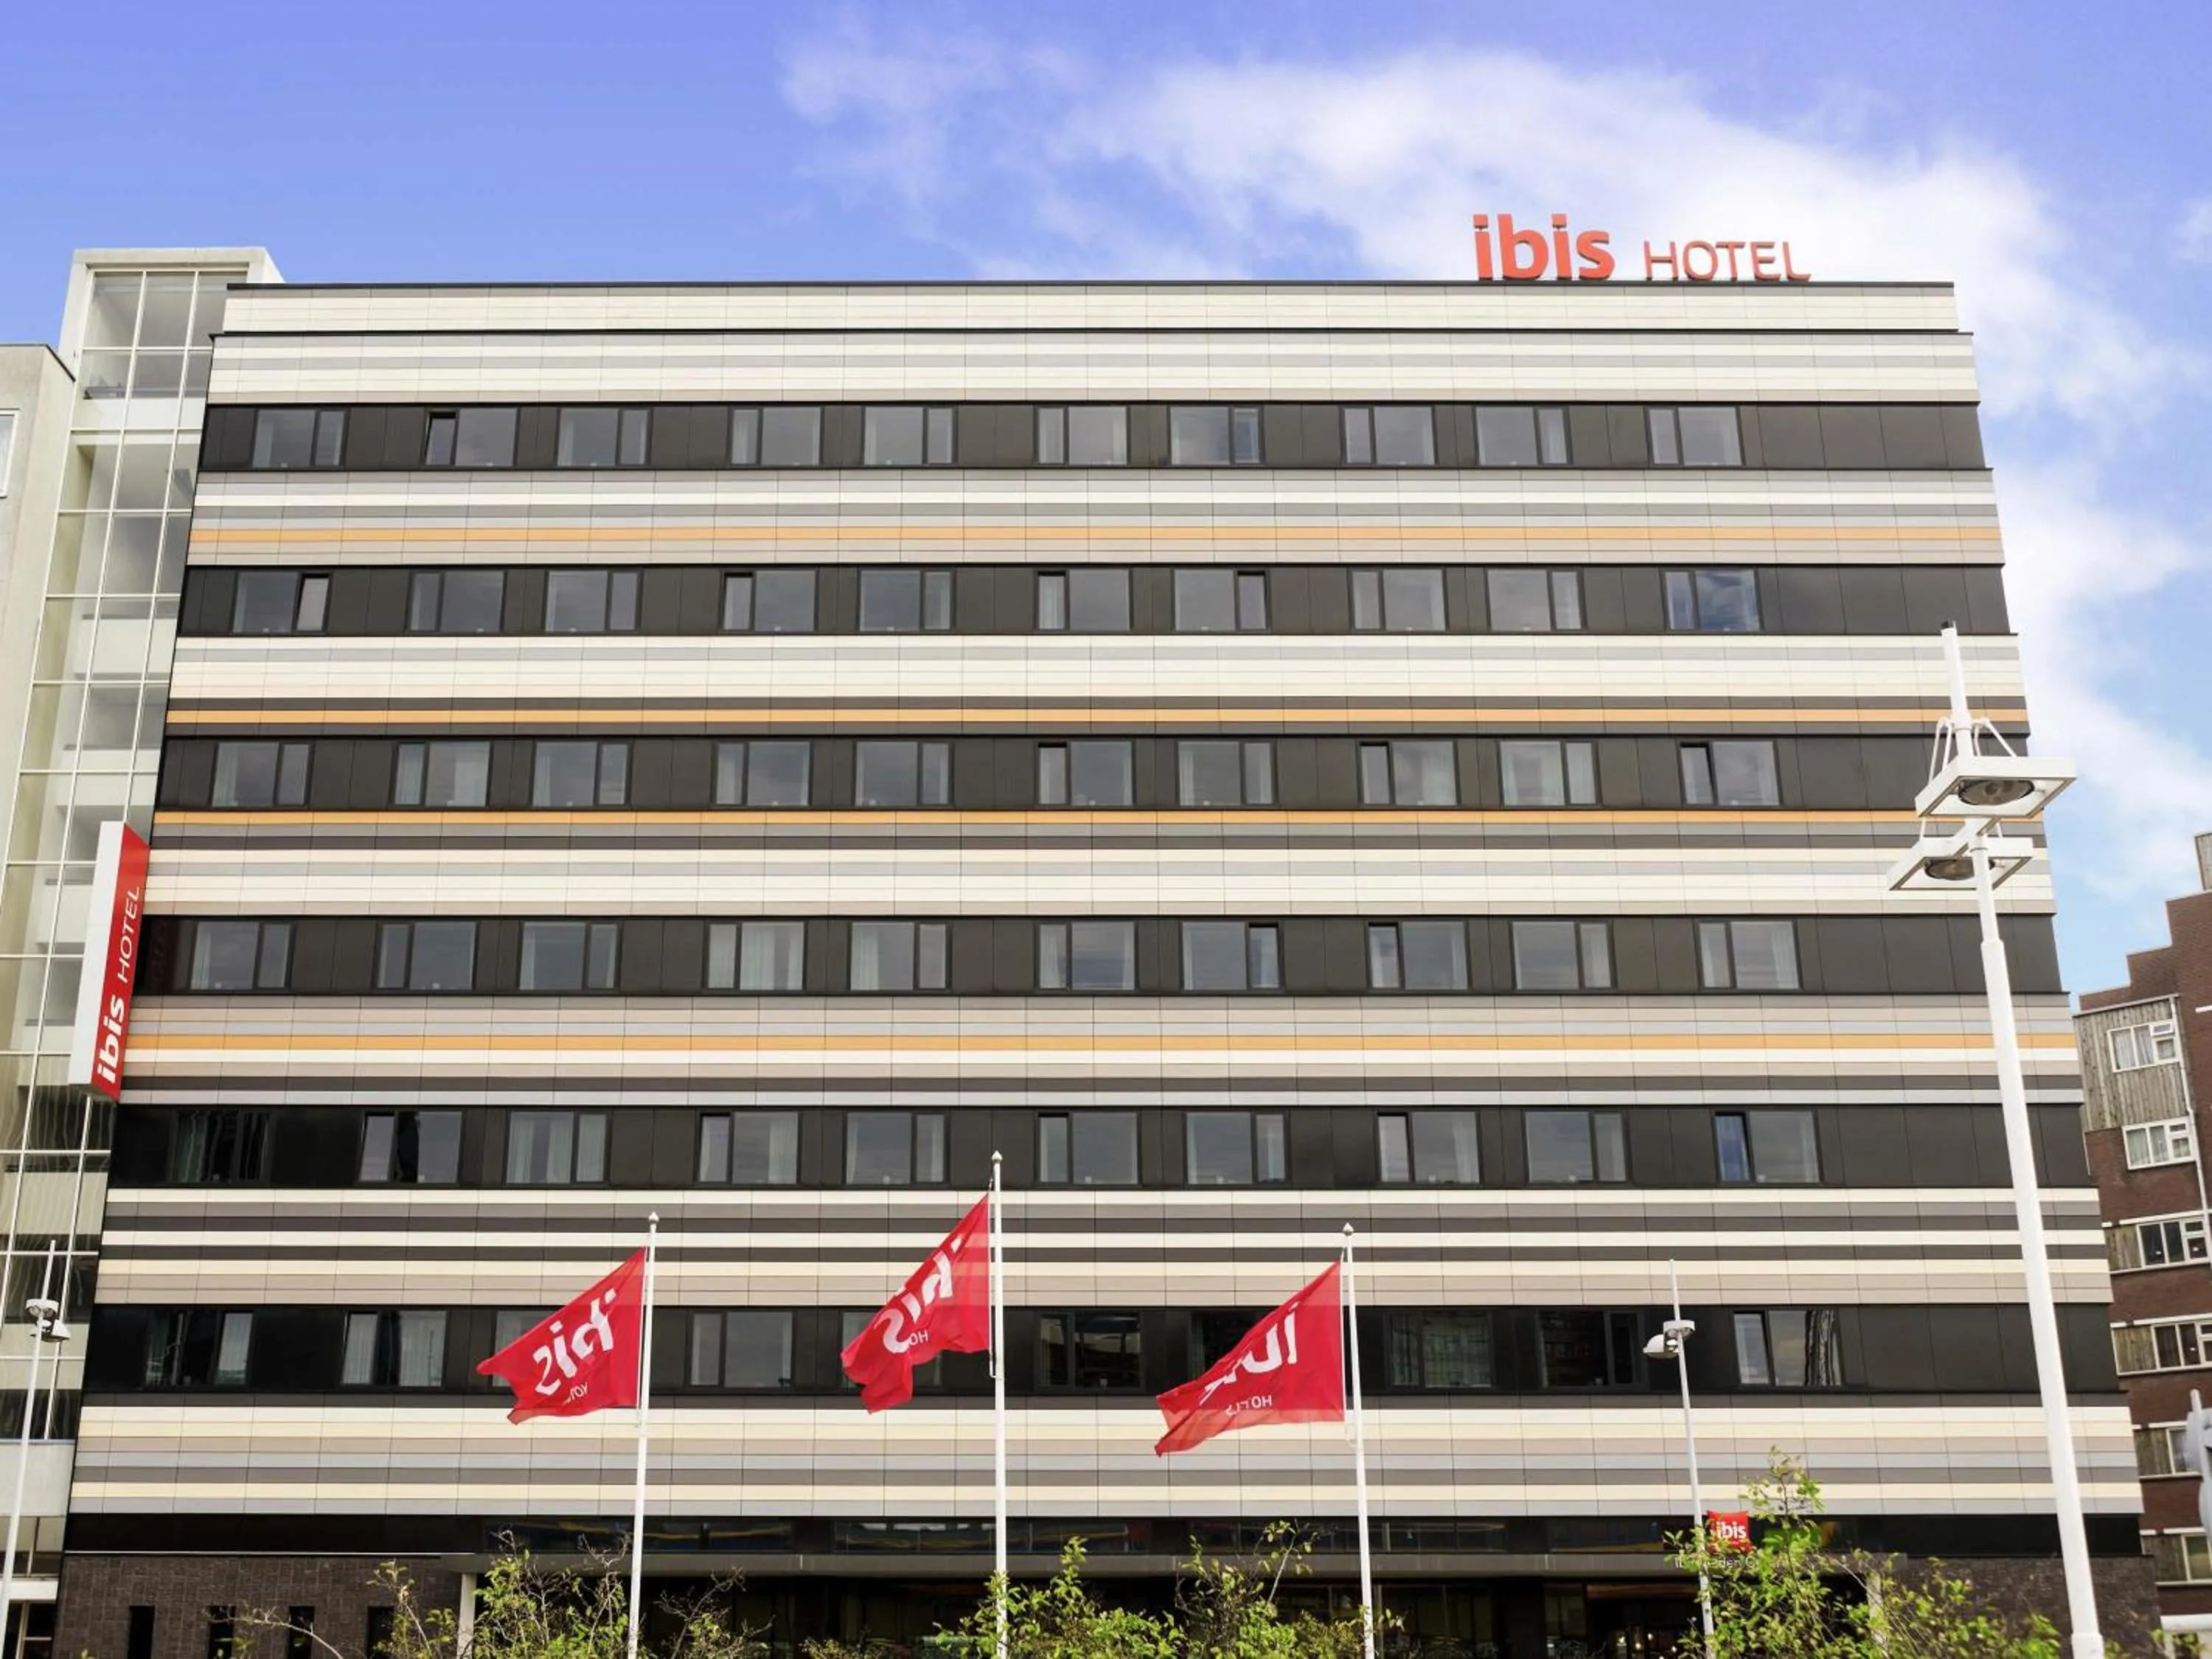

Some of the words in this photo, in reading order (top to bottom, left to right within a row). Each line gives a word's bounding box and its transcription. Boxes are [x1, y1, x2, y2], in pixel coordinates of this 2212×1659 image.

[1473, 214, 1615, 280] ibis
[1644, 240, 1812, 281] HOTEL
[97, 995, 125, 1084] ibis
[117, 885, 141, 983] HOTEL
[1716, 1521, 1747, 1540] ibis
